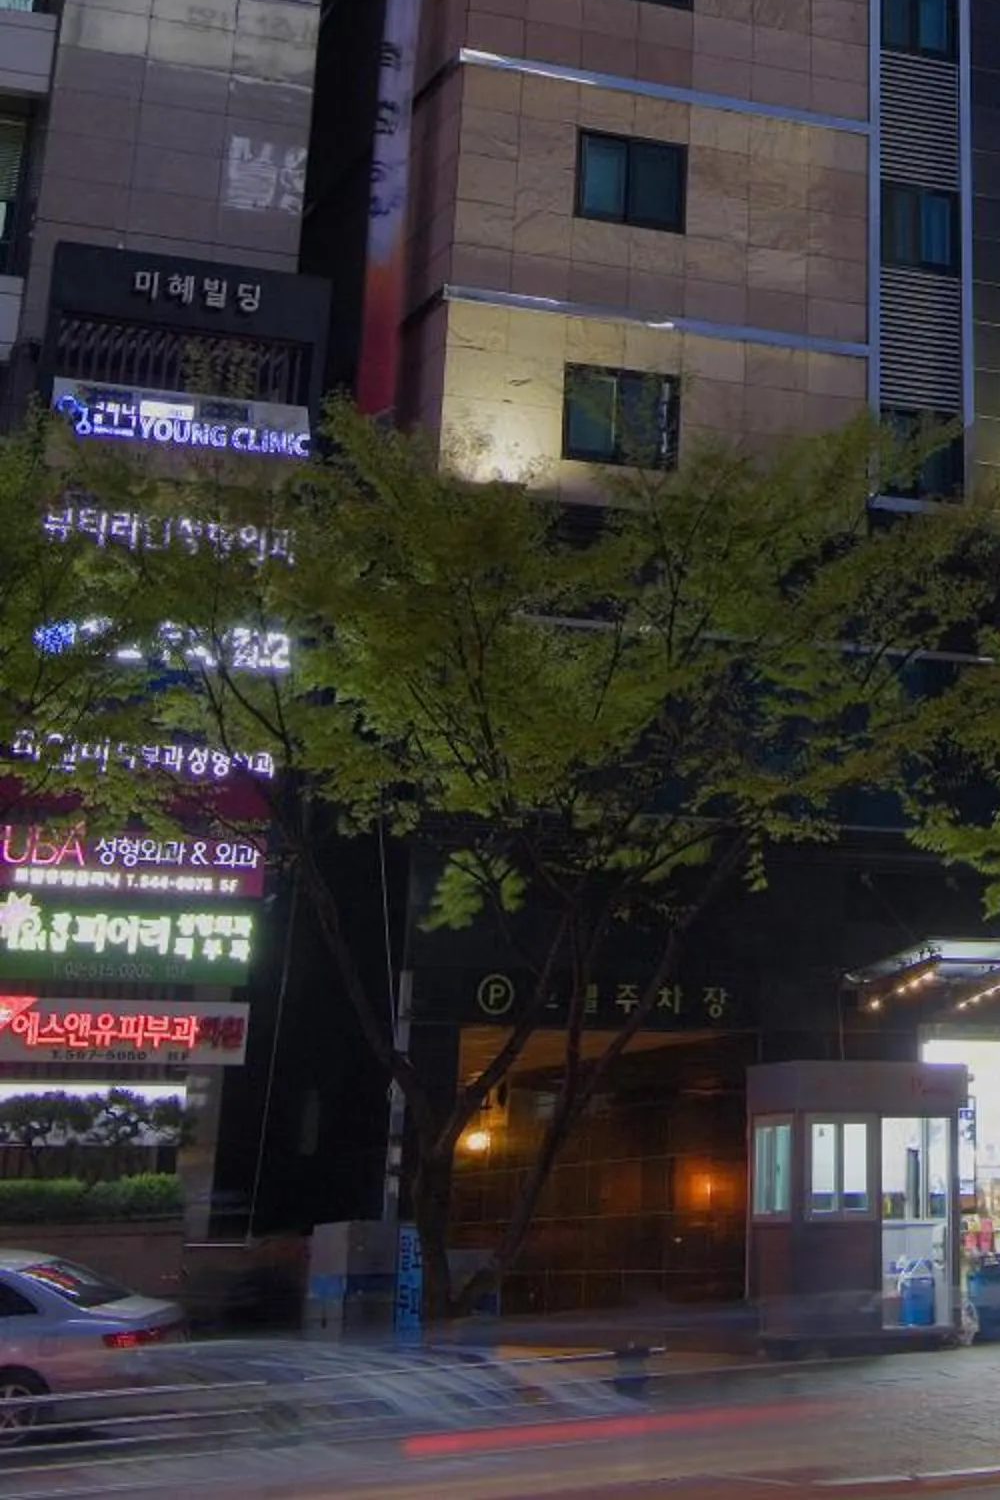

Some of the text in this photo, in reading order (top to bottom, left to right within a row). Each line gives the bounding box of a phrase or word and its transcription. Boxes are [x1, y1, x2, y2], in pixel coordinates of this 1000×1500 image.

[134, 271, 261, 312] 미혜빌딩
[139, 417, 229, 448] YOUNG
[231, 426, 311, 457] CLINIC
[95, 836, 187, 867] 성형외과
[190, 840, 209, 866] &
[213, 841, 262, 869] 외과
